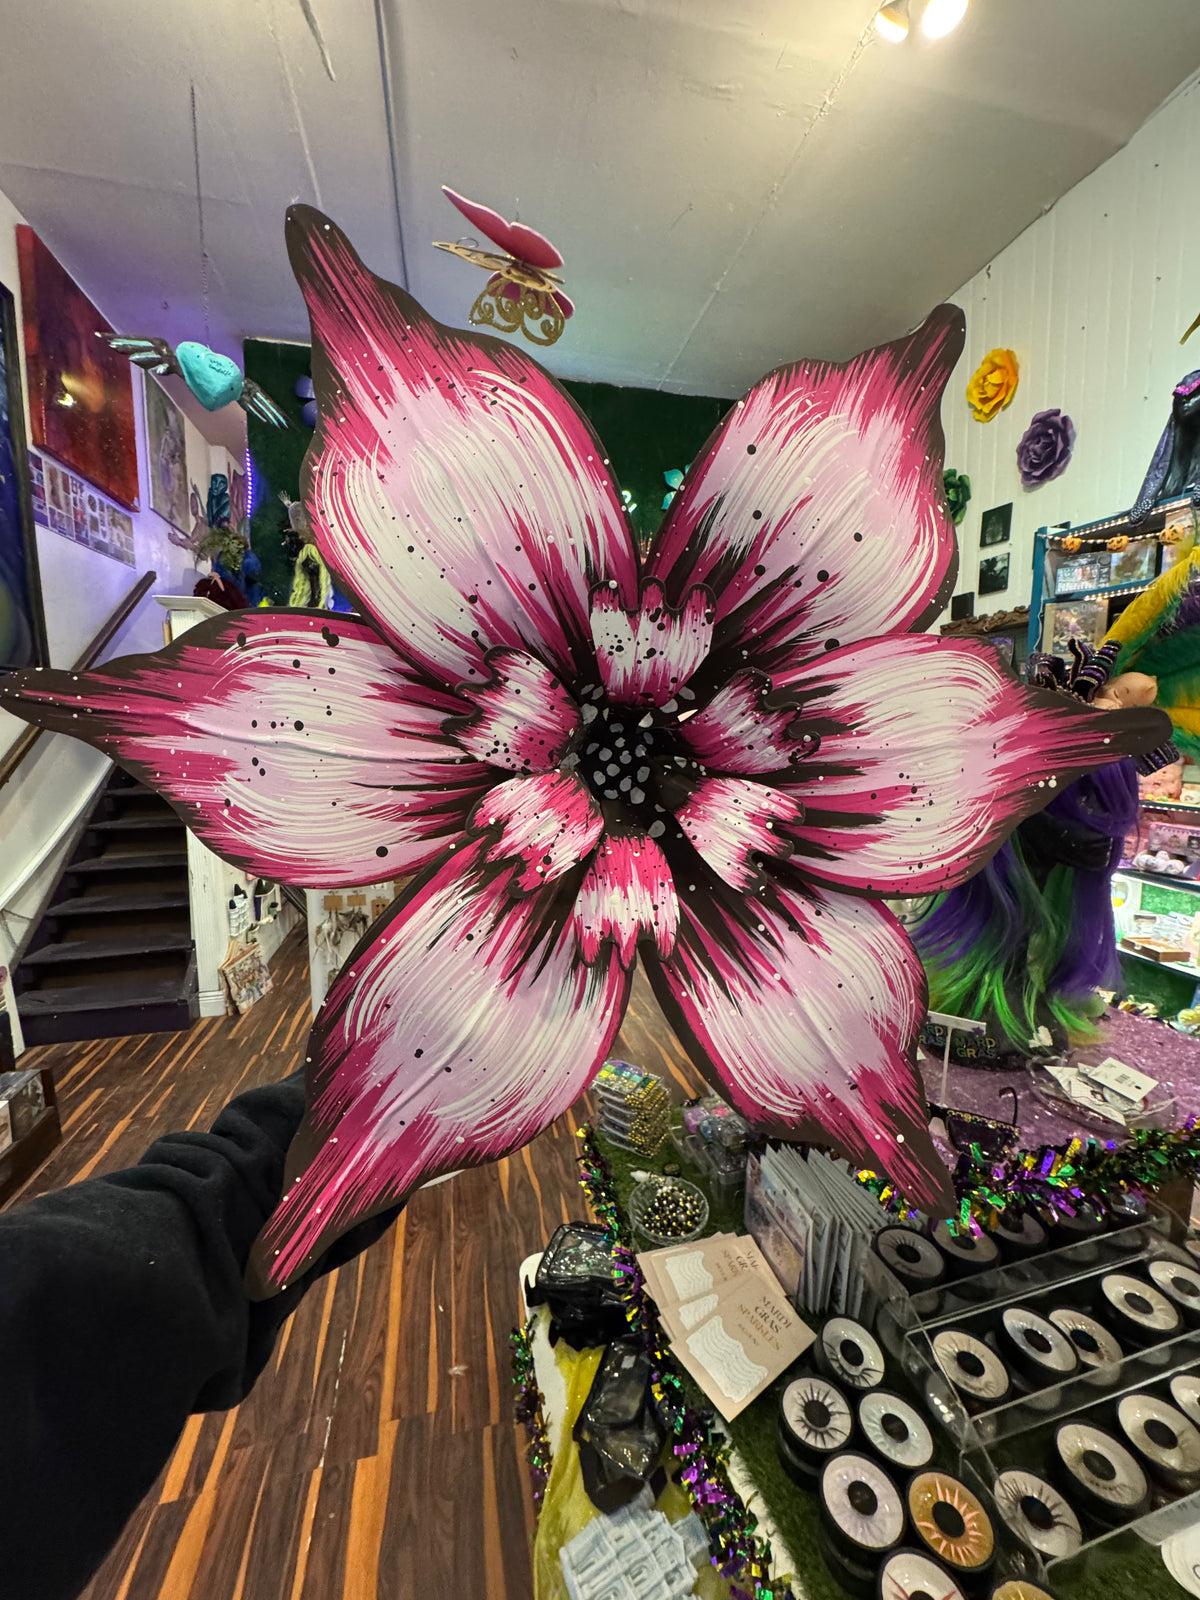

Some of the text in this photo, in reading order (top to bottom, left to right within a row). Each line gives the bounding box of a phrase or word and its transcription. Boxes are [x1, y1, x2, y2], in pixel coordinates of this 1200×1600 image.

[957, 1047, 997, 1060] GRAS
[754, 1305, 781, 1334] GRAS
[762, 1296, 792, 1328] MARDI
